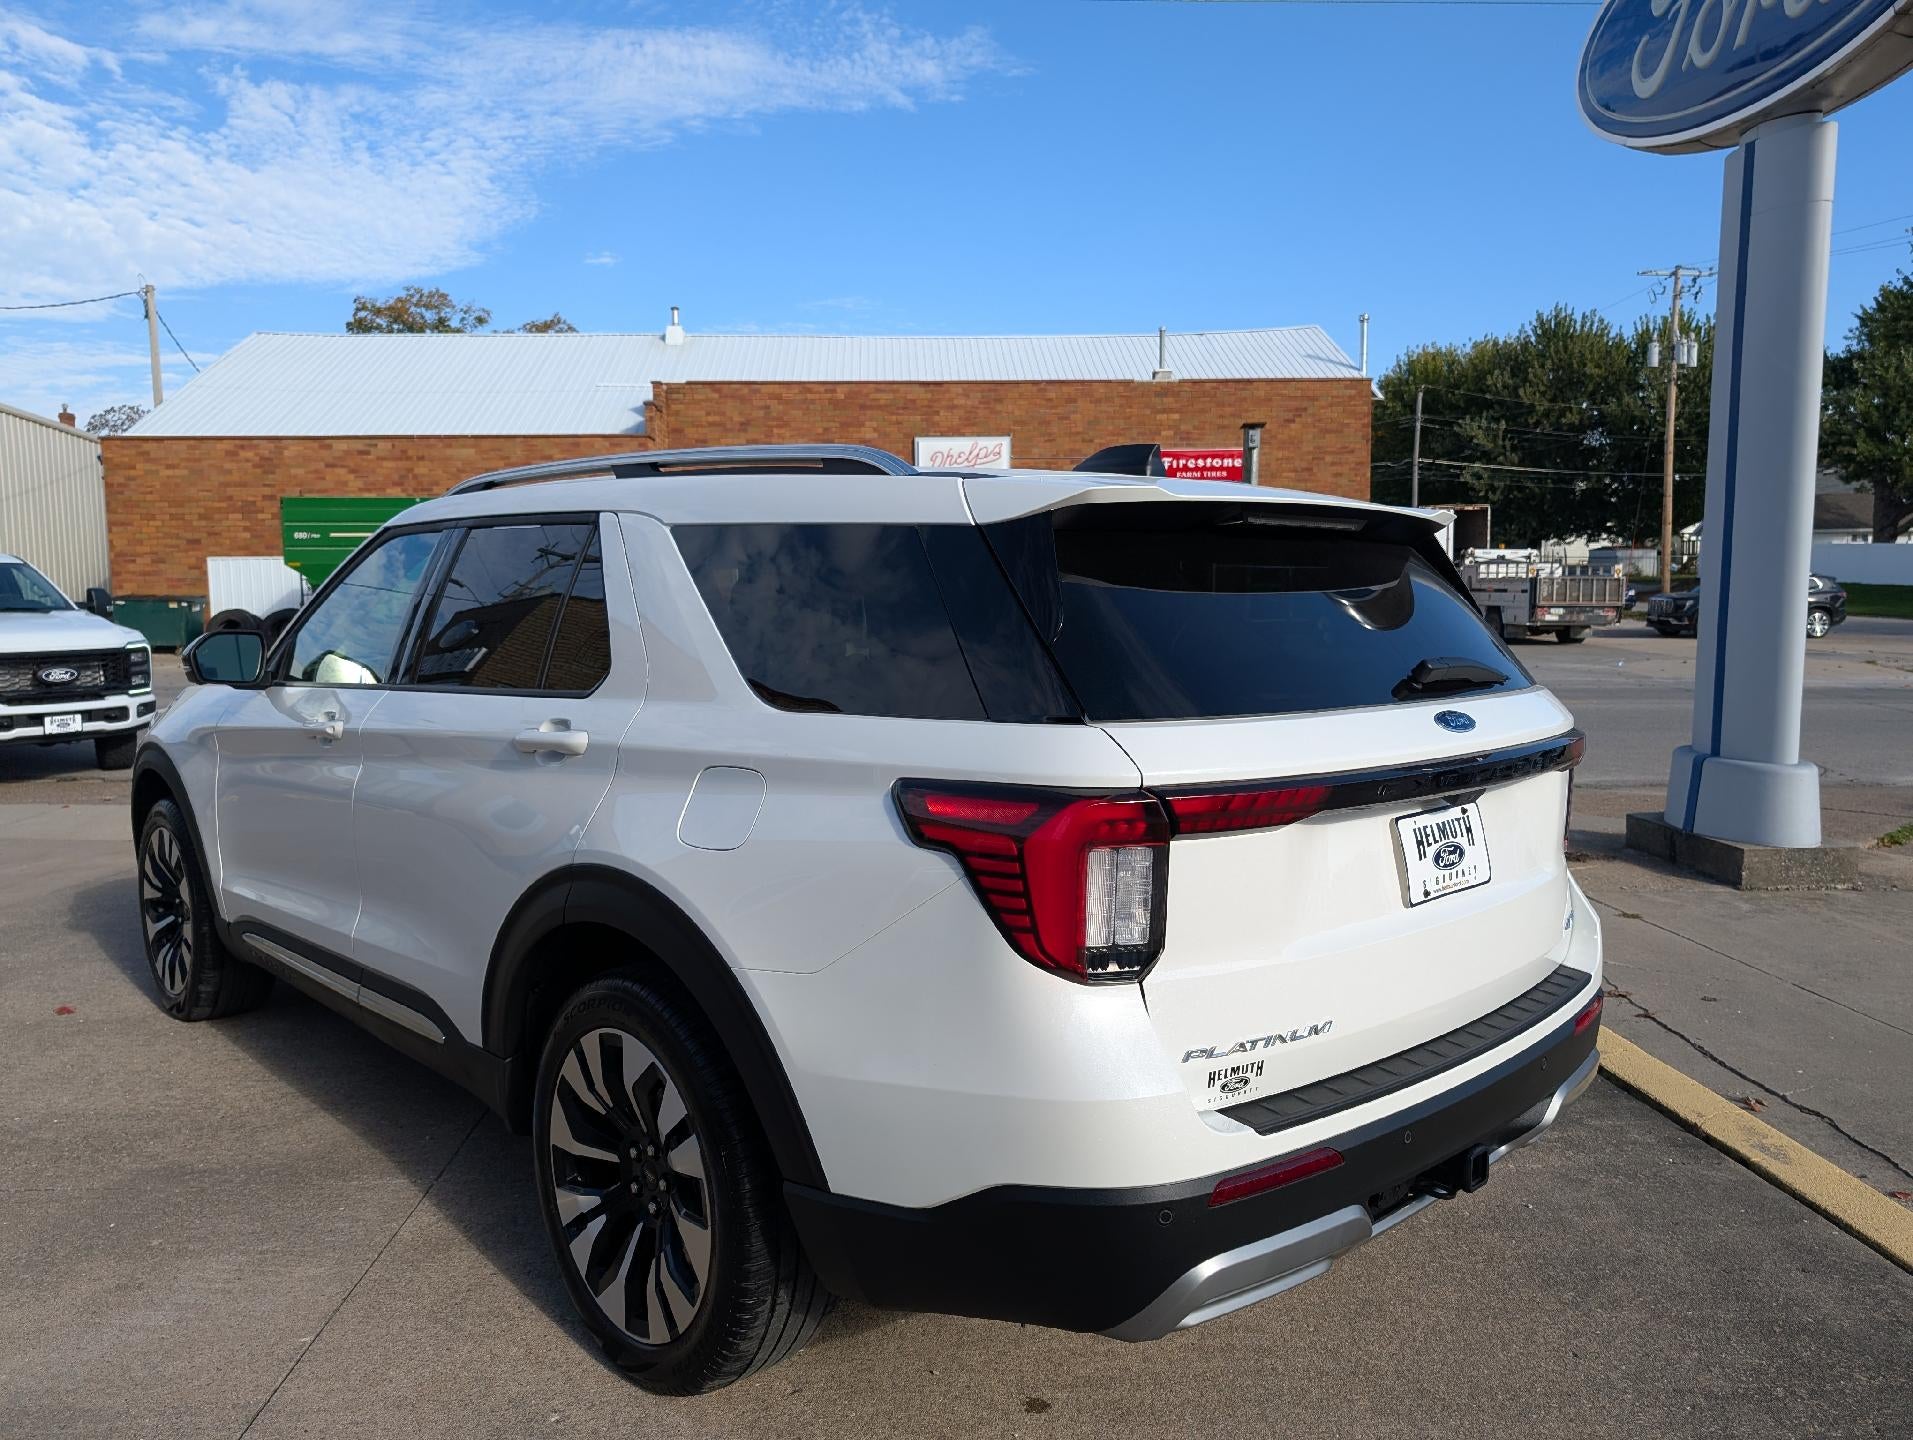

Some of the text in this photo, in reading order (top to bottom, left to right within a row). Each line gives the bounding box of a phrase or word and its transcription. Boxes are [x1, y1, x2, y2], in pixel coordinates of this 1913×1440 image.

[1631, 0, 1824, 98] For
[930, 441, 1003, 468] Phelps
[1161, 456, 1243, 471] Firestone
[1413, 815, 1475, 861] HELMUTH
[1438, 846, 1461, 867] Ford
[1181, 1020, 1334, 1064] PLATINUM
[1207, 1059, 1265, 1089] HELMUTH
